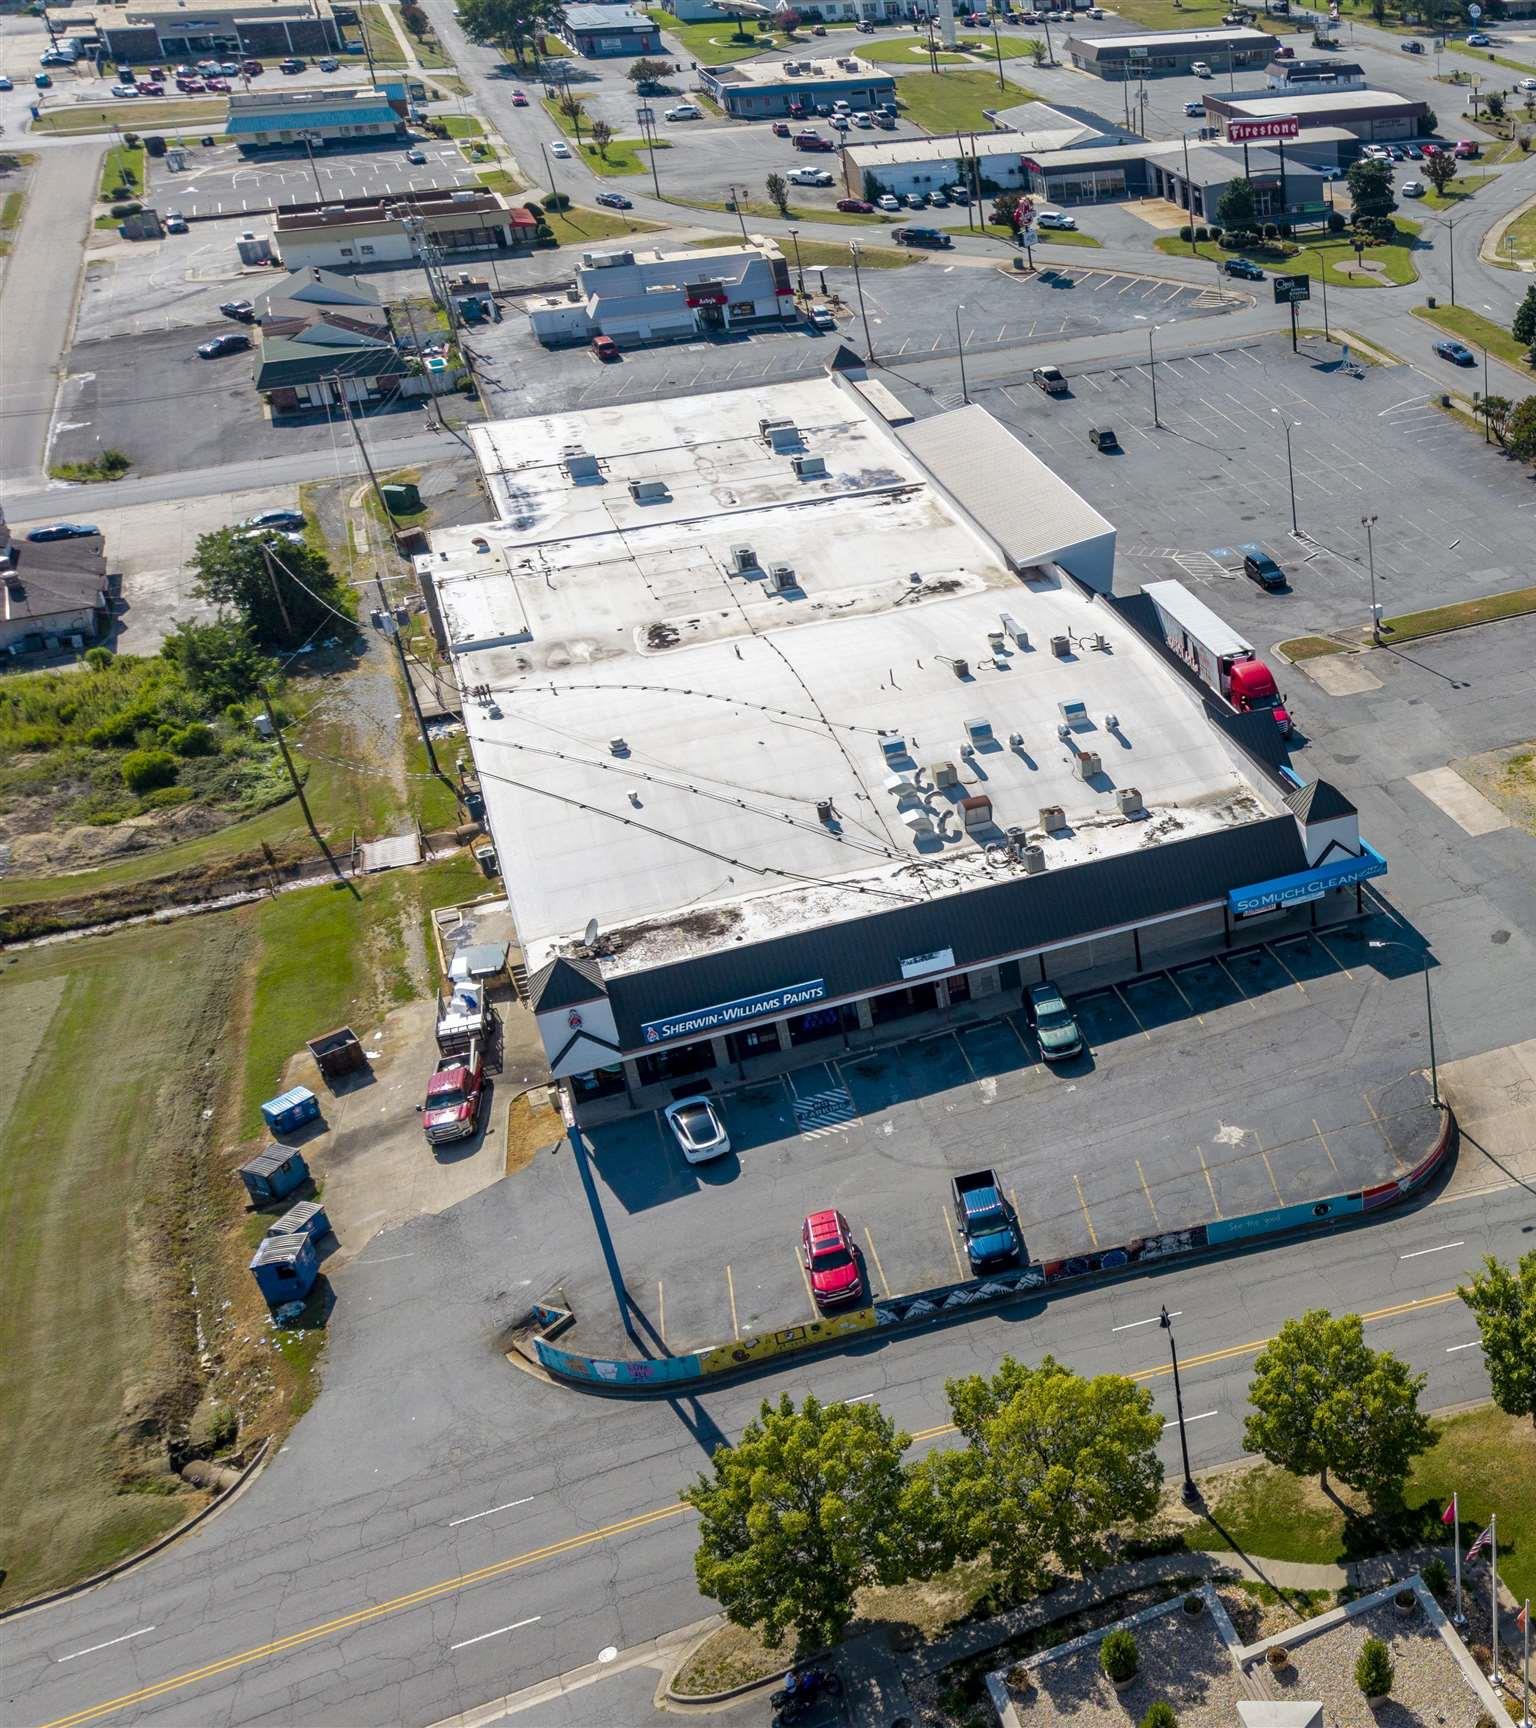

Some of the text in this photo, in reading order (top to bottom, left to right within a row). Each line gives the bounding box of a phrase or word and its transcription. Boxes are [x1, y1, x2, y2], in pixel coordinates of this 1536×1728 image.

[1230, 122, 1297, 139] Firestone
[1237, 897, 1259, 911] SO
[1261, 887, 1305, 906] MUCH
[1307, 873, 1358, 893] CLEAN
[661, 987, 824, 1038] SHERWIN-WILLIAMS PAINTS
